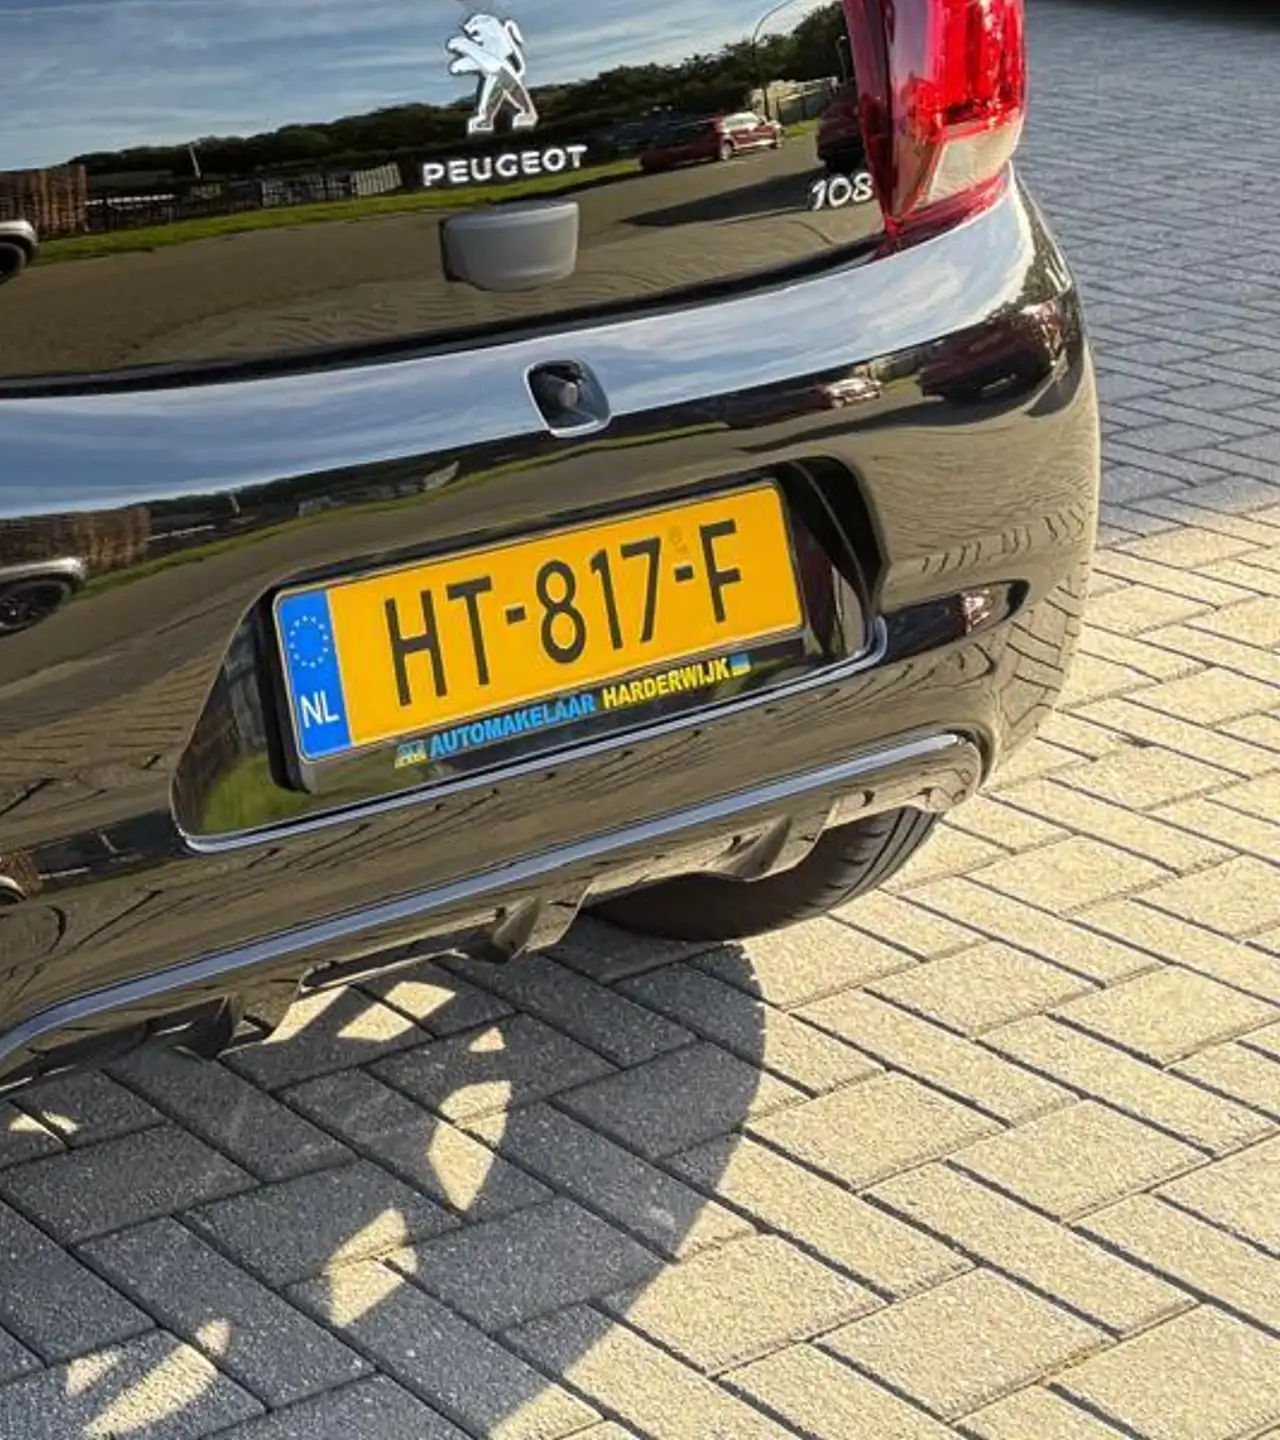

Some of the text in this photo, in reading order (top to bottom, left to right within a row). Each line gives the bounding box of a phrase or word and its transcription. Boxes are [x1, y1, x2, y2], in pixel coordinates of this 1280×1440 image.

[422, 144, 588, 187] PEUGEOT
[811, 171, 874, 211] 108
[384, 519, 743, 707] HT-817-F
[300, 688, 339, 729] NL
[429, 692, 596, 759] AUTOMAKELAAR
[603, 657, 730, 710] HARDERWIJK
